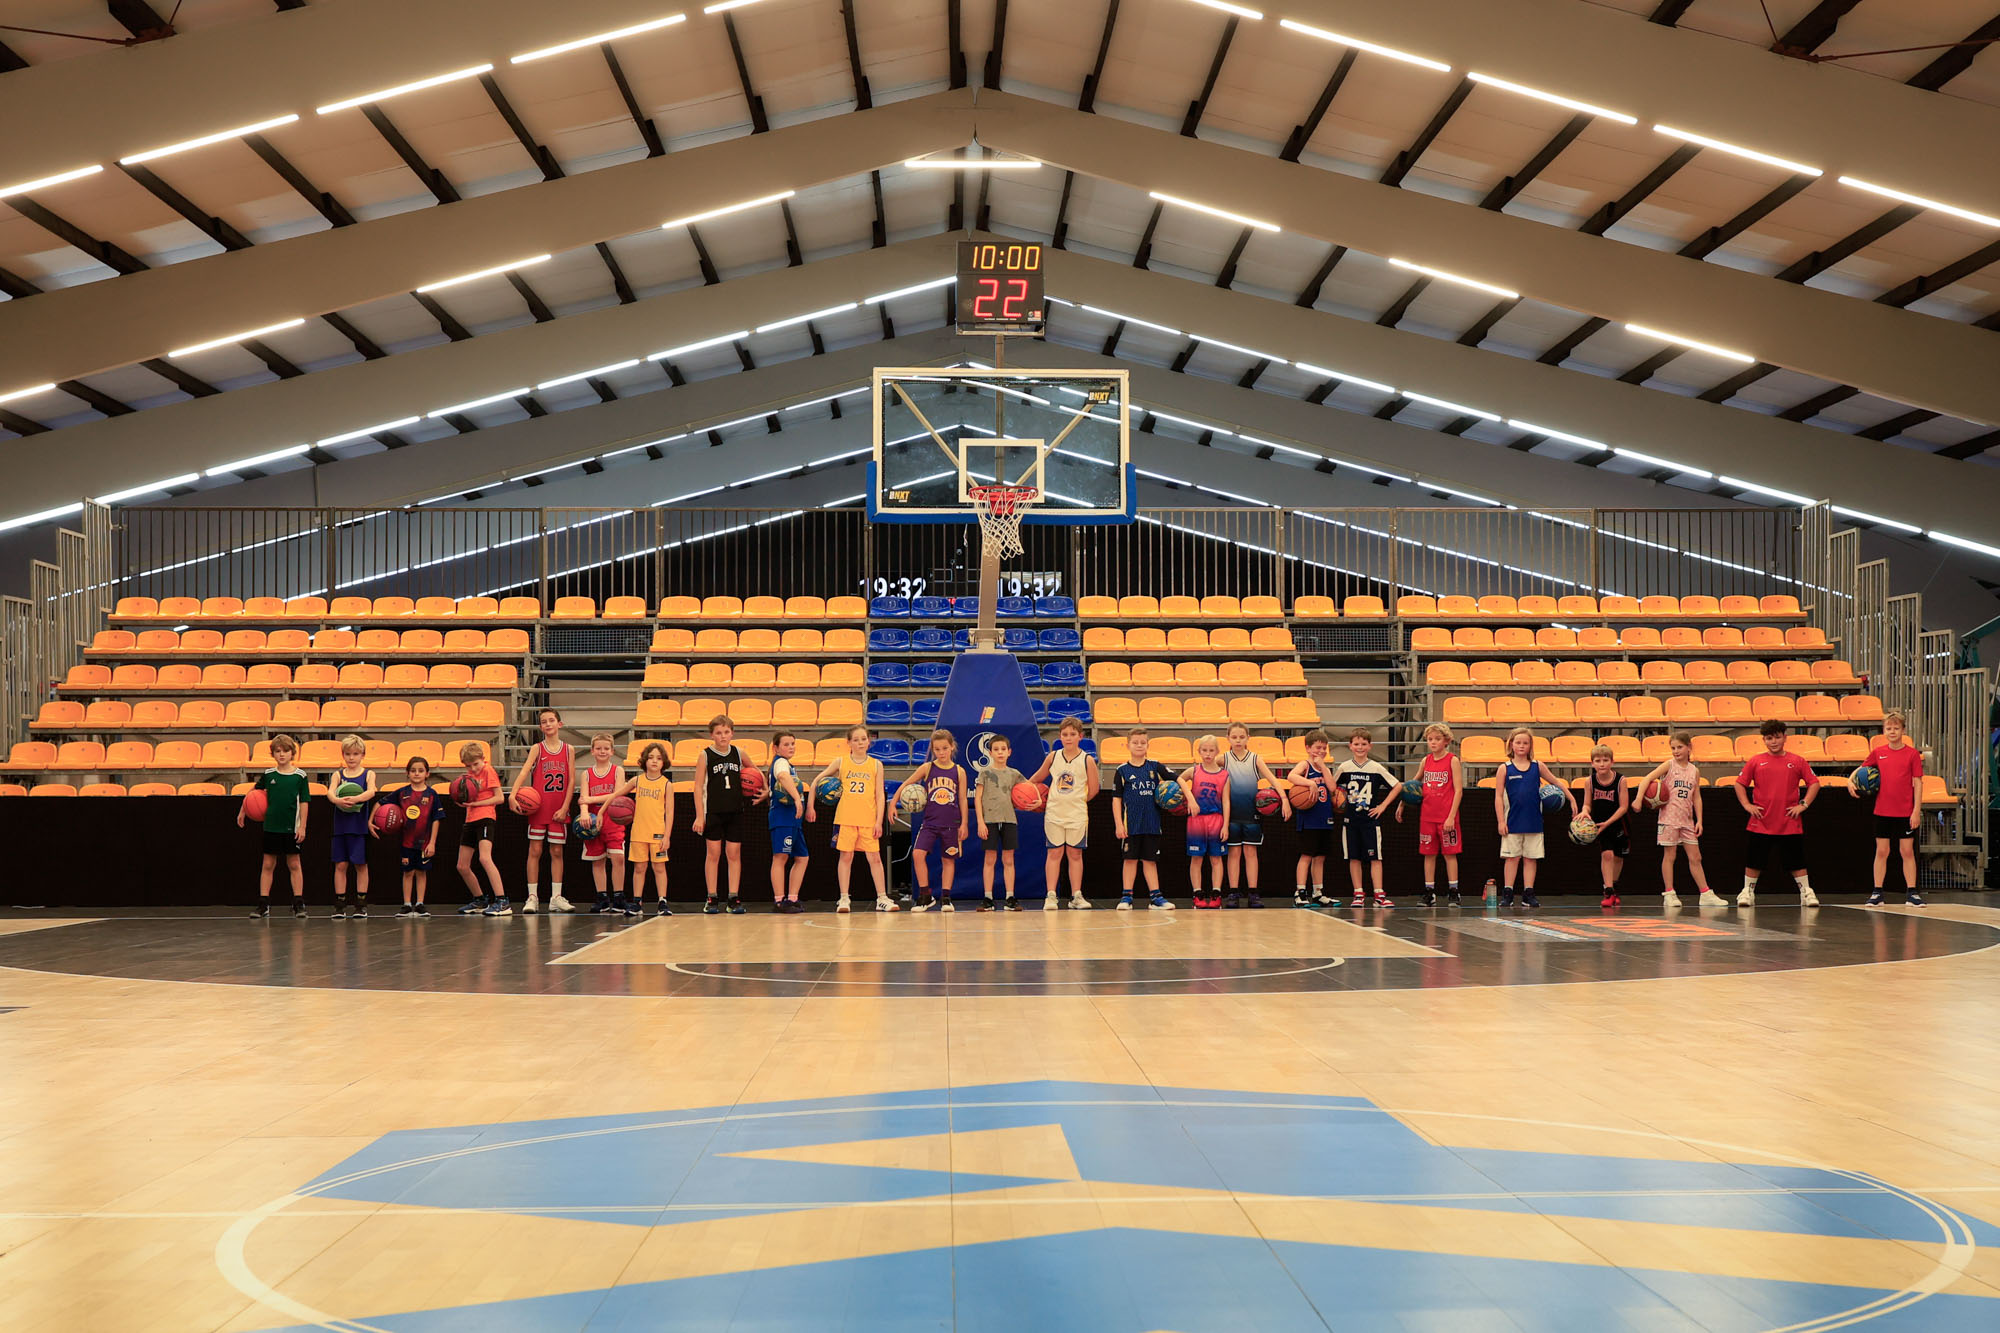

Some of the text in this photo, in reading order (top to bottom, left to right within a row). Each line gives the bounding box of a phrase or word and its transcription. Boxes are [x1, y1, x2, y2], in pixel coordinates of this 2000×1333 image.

[973, 245, 1040, 270] 10:00
[974, 279, 1028, 317] 22
[889, 490, 910, 500] BNXT
[859, 577, 927, 600] 19:32
[543, 761, 565, 773] BULLS
[845, 770, 871, 780] LAKERS
[1423, 770, 1448, 783] BULLS
[544, 773, 565, 792] 23
[724, 775, 731, 789] 1
[850, 781, 865, 794] 23
[928, 776, 957, 794] LAKERS
[1674, 780, 1693, 791] BULLS
[1677, 789, 1689, 799] 23
